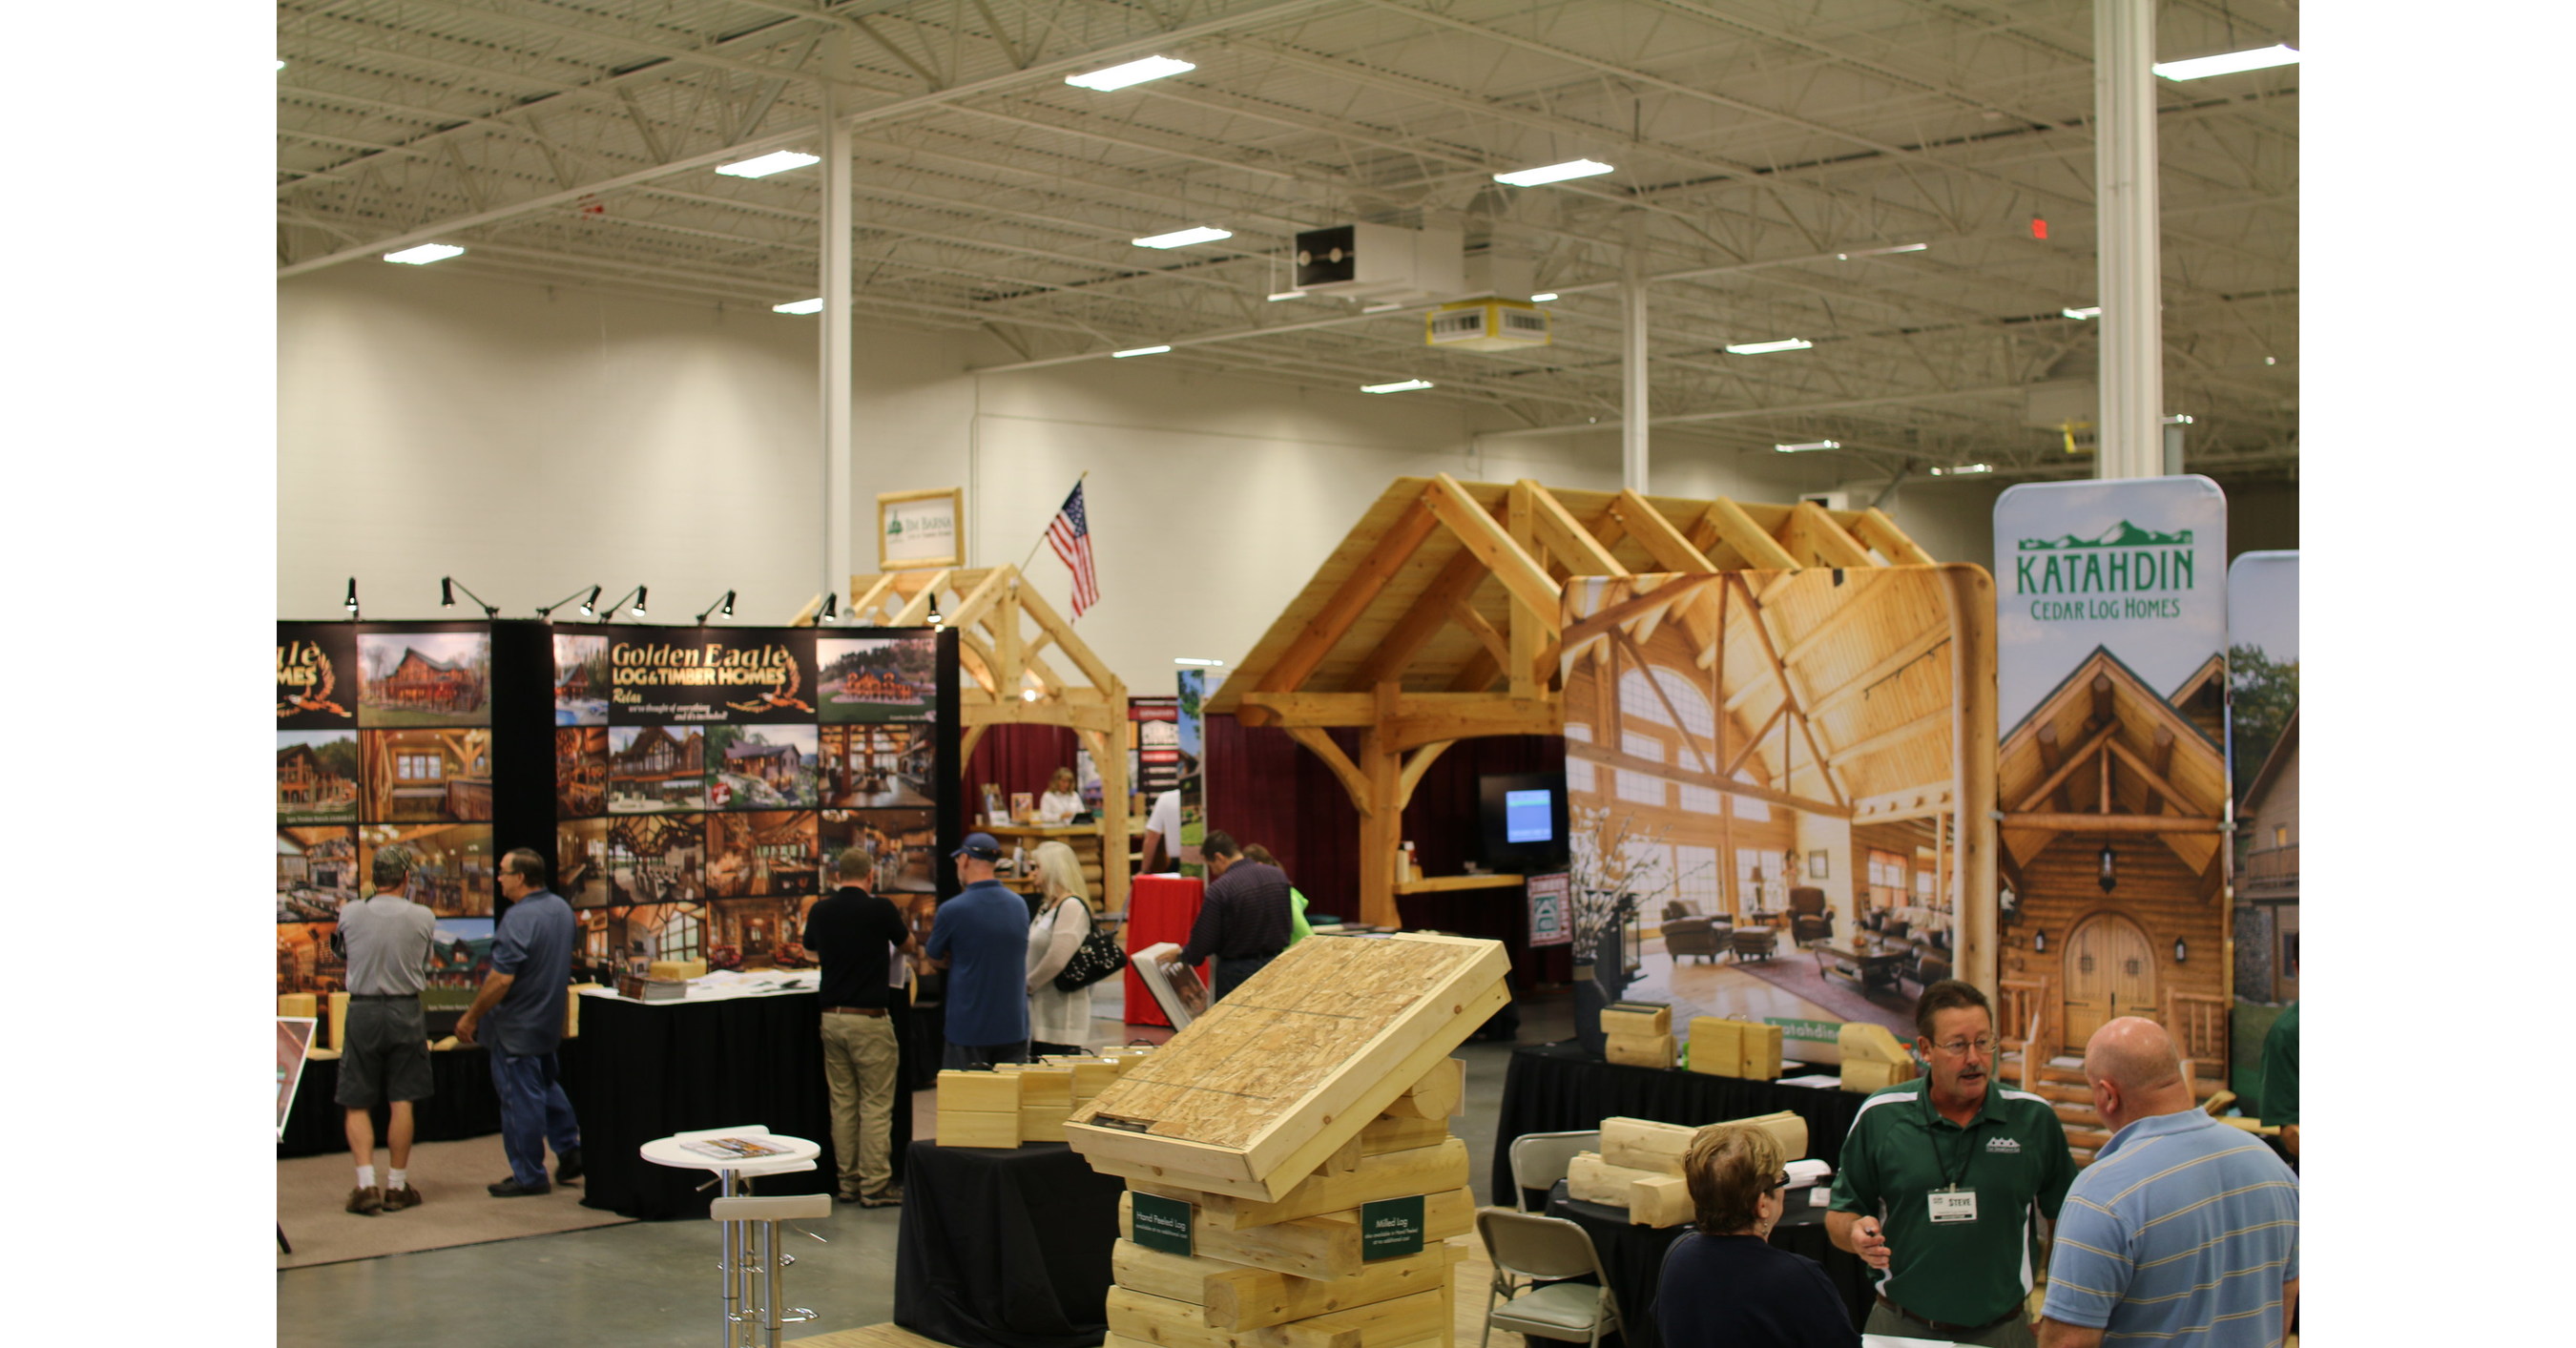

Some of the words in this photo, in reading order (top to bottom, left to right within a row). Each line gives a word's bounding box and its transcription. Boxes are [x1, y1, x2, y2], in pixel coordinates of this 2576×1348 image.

[922, 515, 952, 530] BARNA
[2017, 549, 2194, 594] KATAHDIN
[2030, 599, 2085, 621] CEDAR
[2089, 598, 2119, 620] LOG
[2125, 597, 2181, 619] HOMES
[612, 642, 700, 667] Golden
[704, 643, 790, 672] Eagle
[717, 667, 787, 686] HOMES
[1948, 1198, 1971, 1207] STEVE
[1136, 1211, 1153, 1223] Hand
[1153, 1214, 1174, 1227] Peeled
[1174, 1219, 1186, 1232] Log
[1376, 1217, 1396, 1228] Milled
[1396, 1217, 1408, 1228] Log
